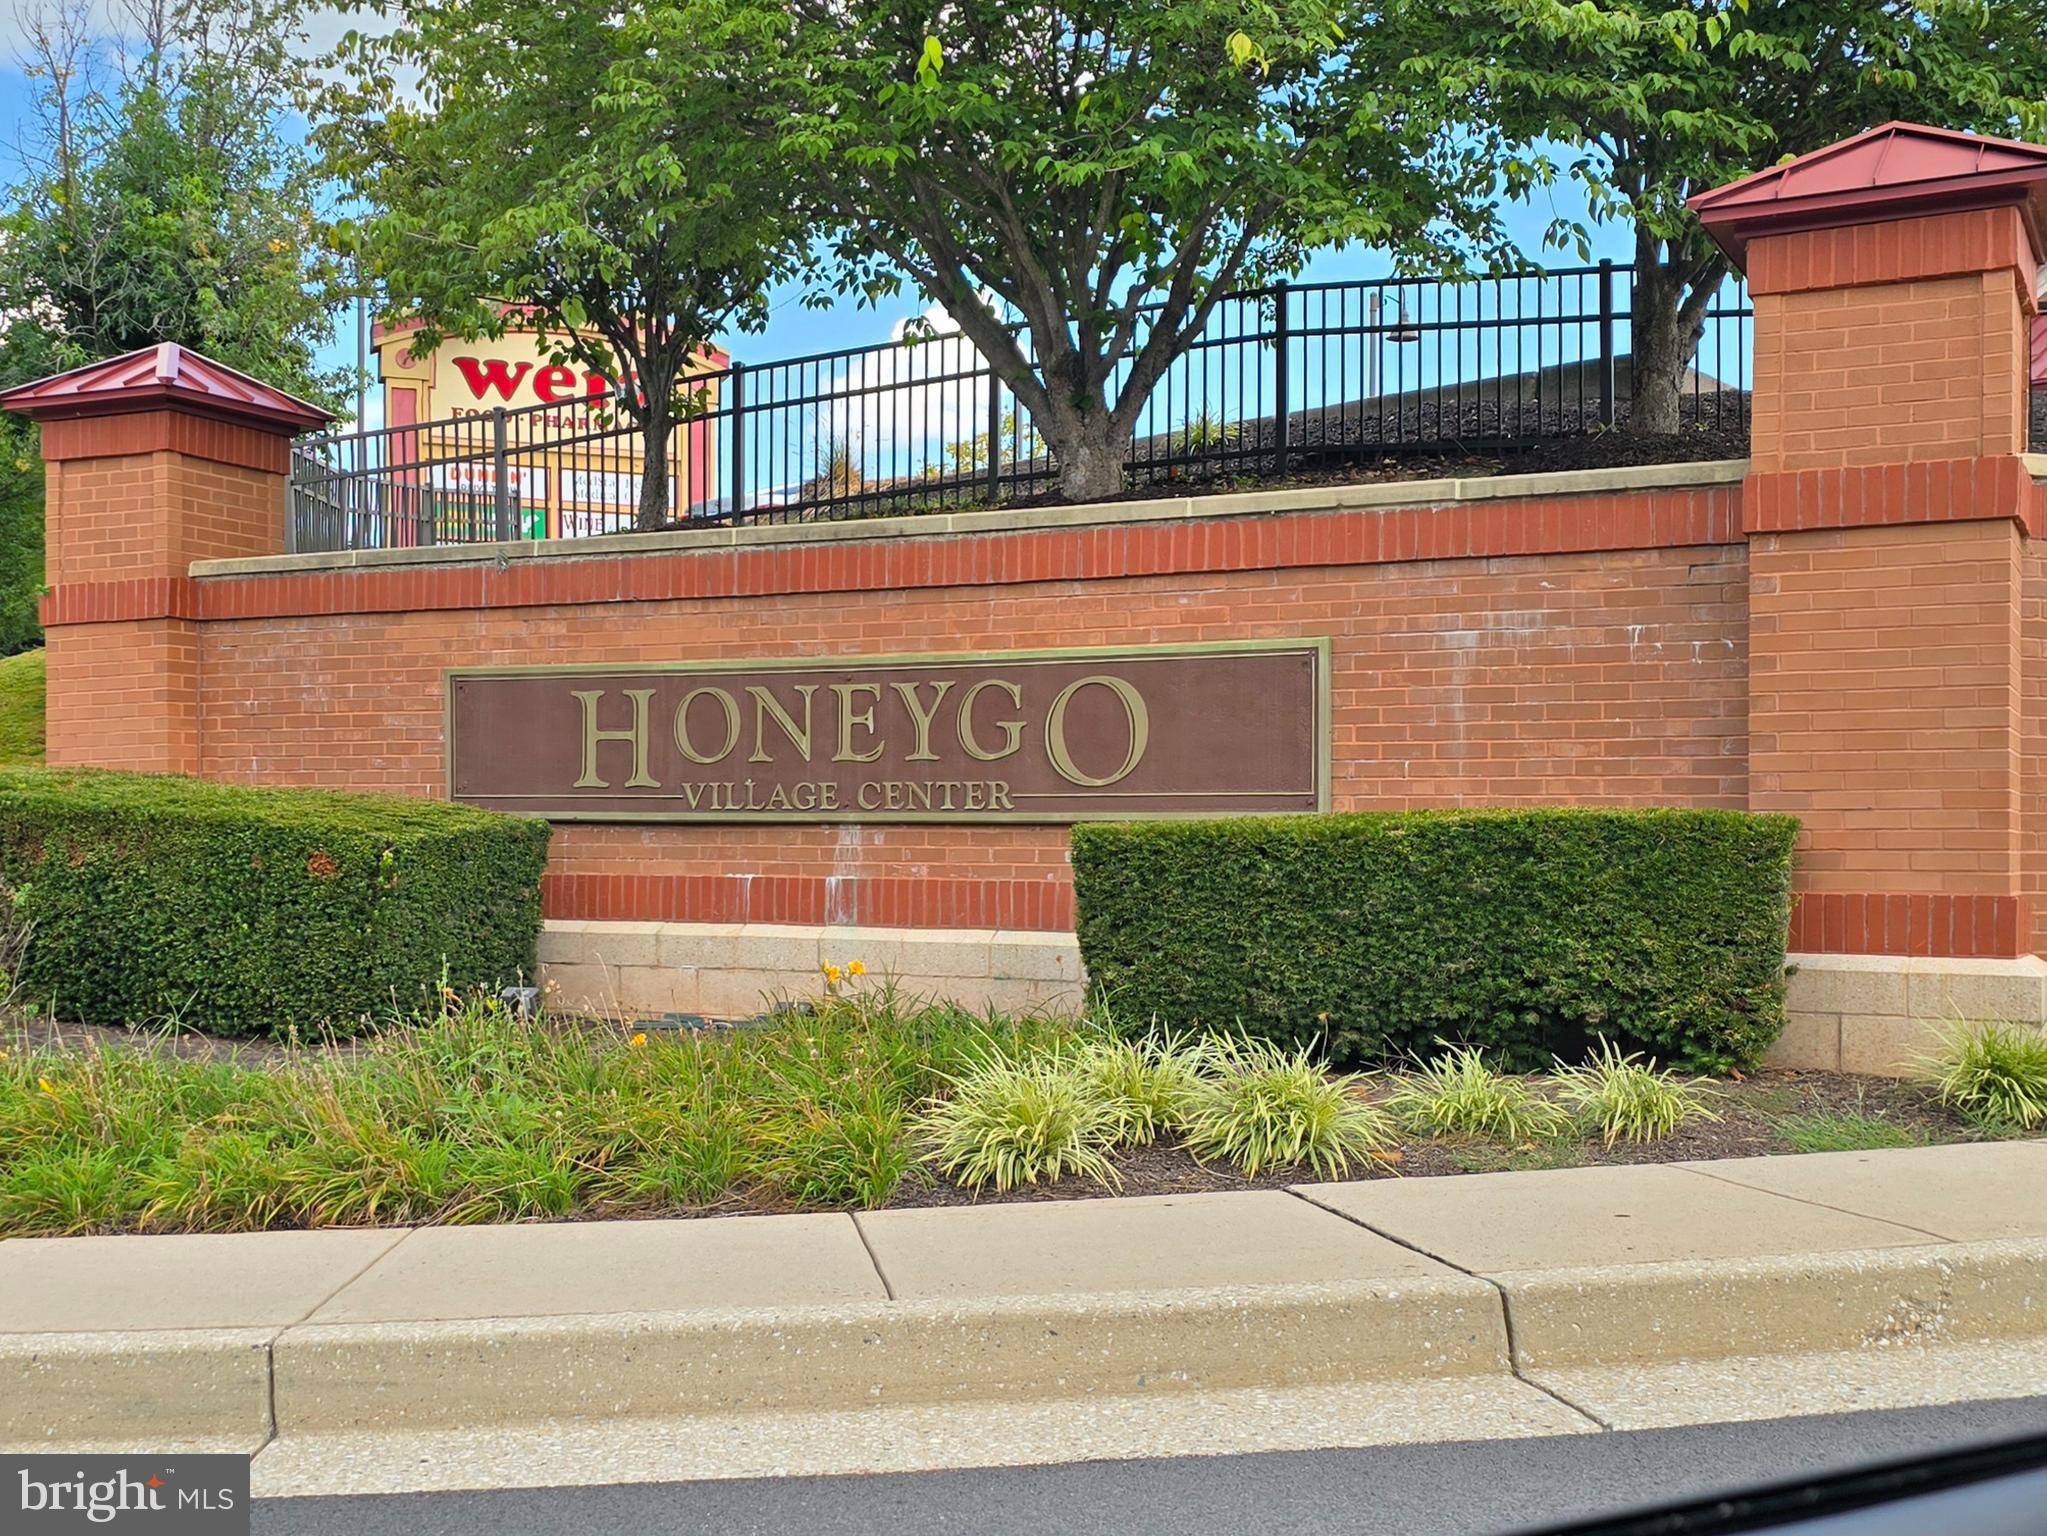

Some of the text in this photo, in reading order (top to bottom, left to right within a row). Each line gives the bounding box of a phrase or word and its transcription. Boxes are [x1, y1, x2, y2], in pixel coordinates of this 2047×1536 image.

[571, 675, 1149, 790] HONEYGO
[681, 779, 1014, 811] VILLAGE CENTER
